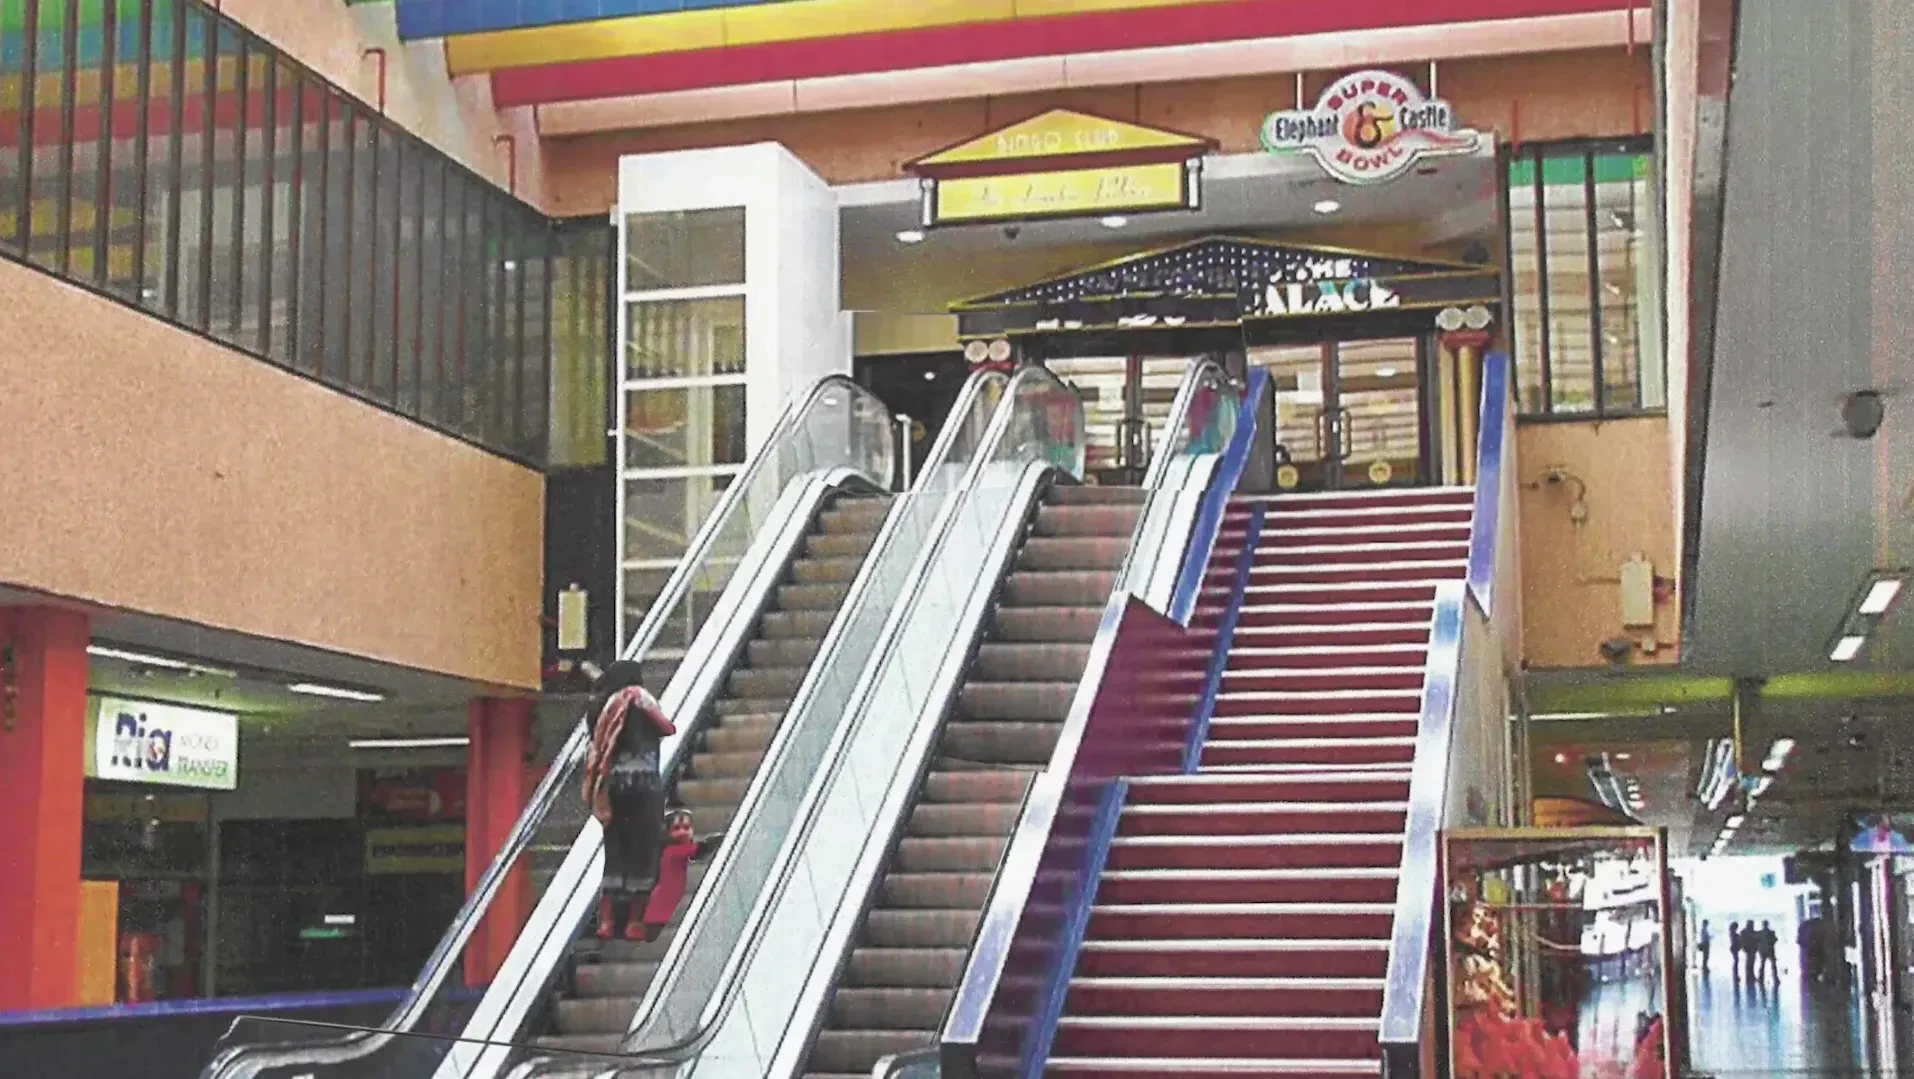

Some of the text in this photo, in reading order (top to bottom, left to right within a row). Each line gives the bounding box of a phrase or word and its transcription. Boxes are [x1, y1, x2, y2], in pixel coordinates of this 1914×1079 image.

[1327, 79, 1408, 110] SUPER
[1275, 114, 1339, 142] Elephant
[1400, 104, 1447, 129] Castle
[1335, 146, 1403, 170] BOWL
[111, 712, 172, 772] Ria
